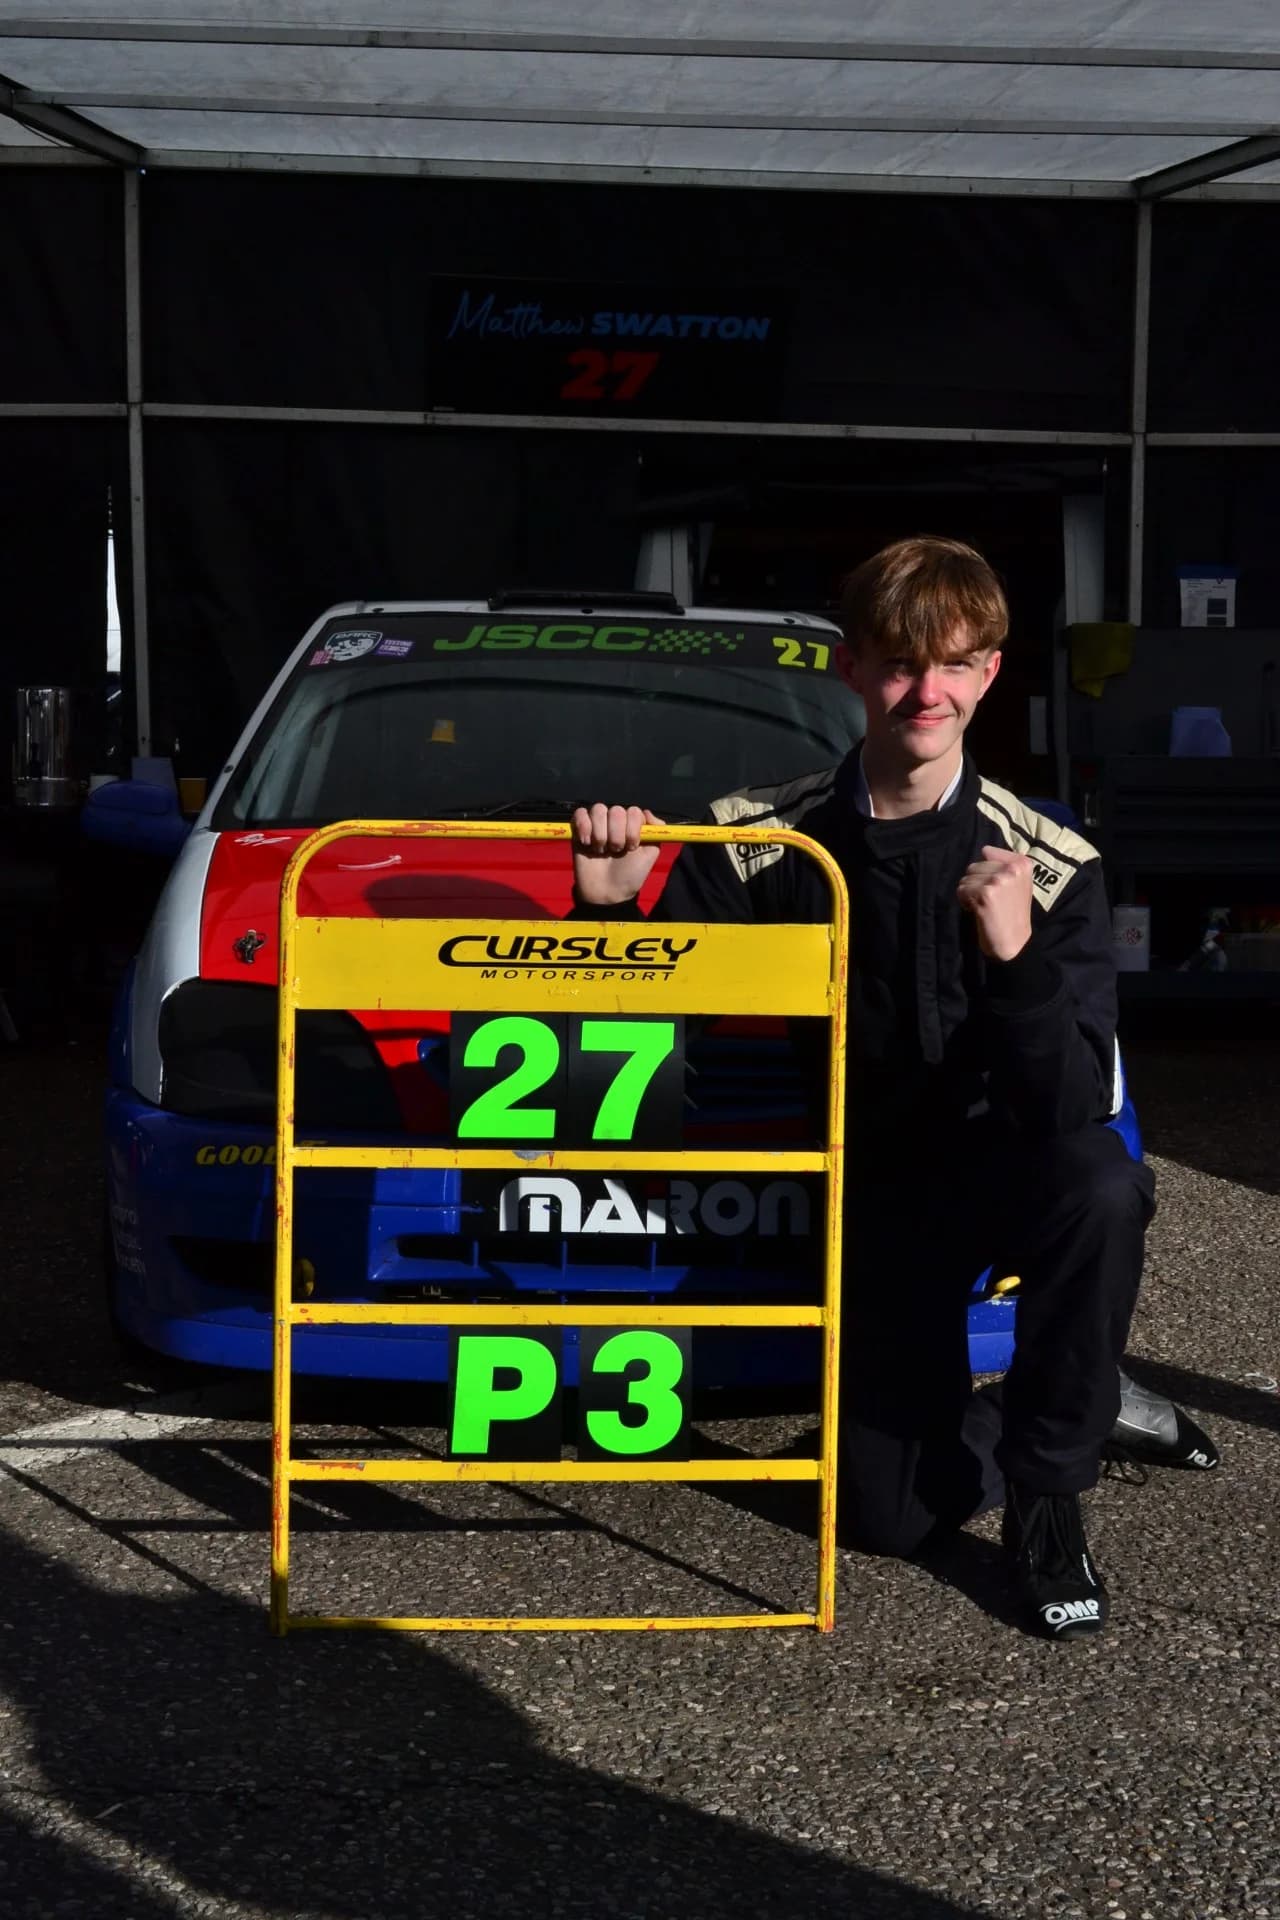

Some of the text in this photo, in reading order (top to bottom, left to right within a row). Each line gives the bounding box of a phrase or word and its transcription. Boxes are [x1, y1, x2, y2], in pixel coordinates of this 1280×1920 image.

[445, 287, 773, 344] Matthew SWATTON
[559, 346, 664, 401] 27
[433, 623, 652, 652] JSCC
[772, 636, 831, 671] 27
[1032, 864, 1058, 886] MP
[438, 935, 698, 970] CURSLEY
[480, 968, 675, 982] MOTORSPORT
[457, 1015, 676, 1142] 27
[1044, 1598, 1100, 1625] OMP
